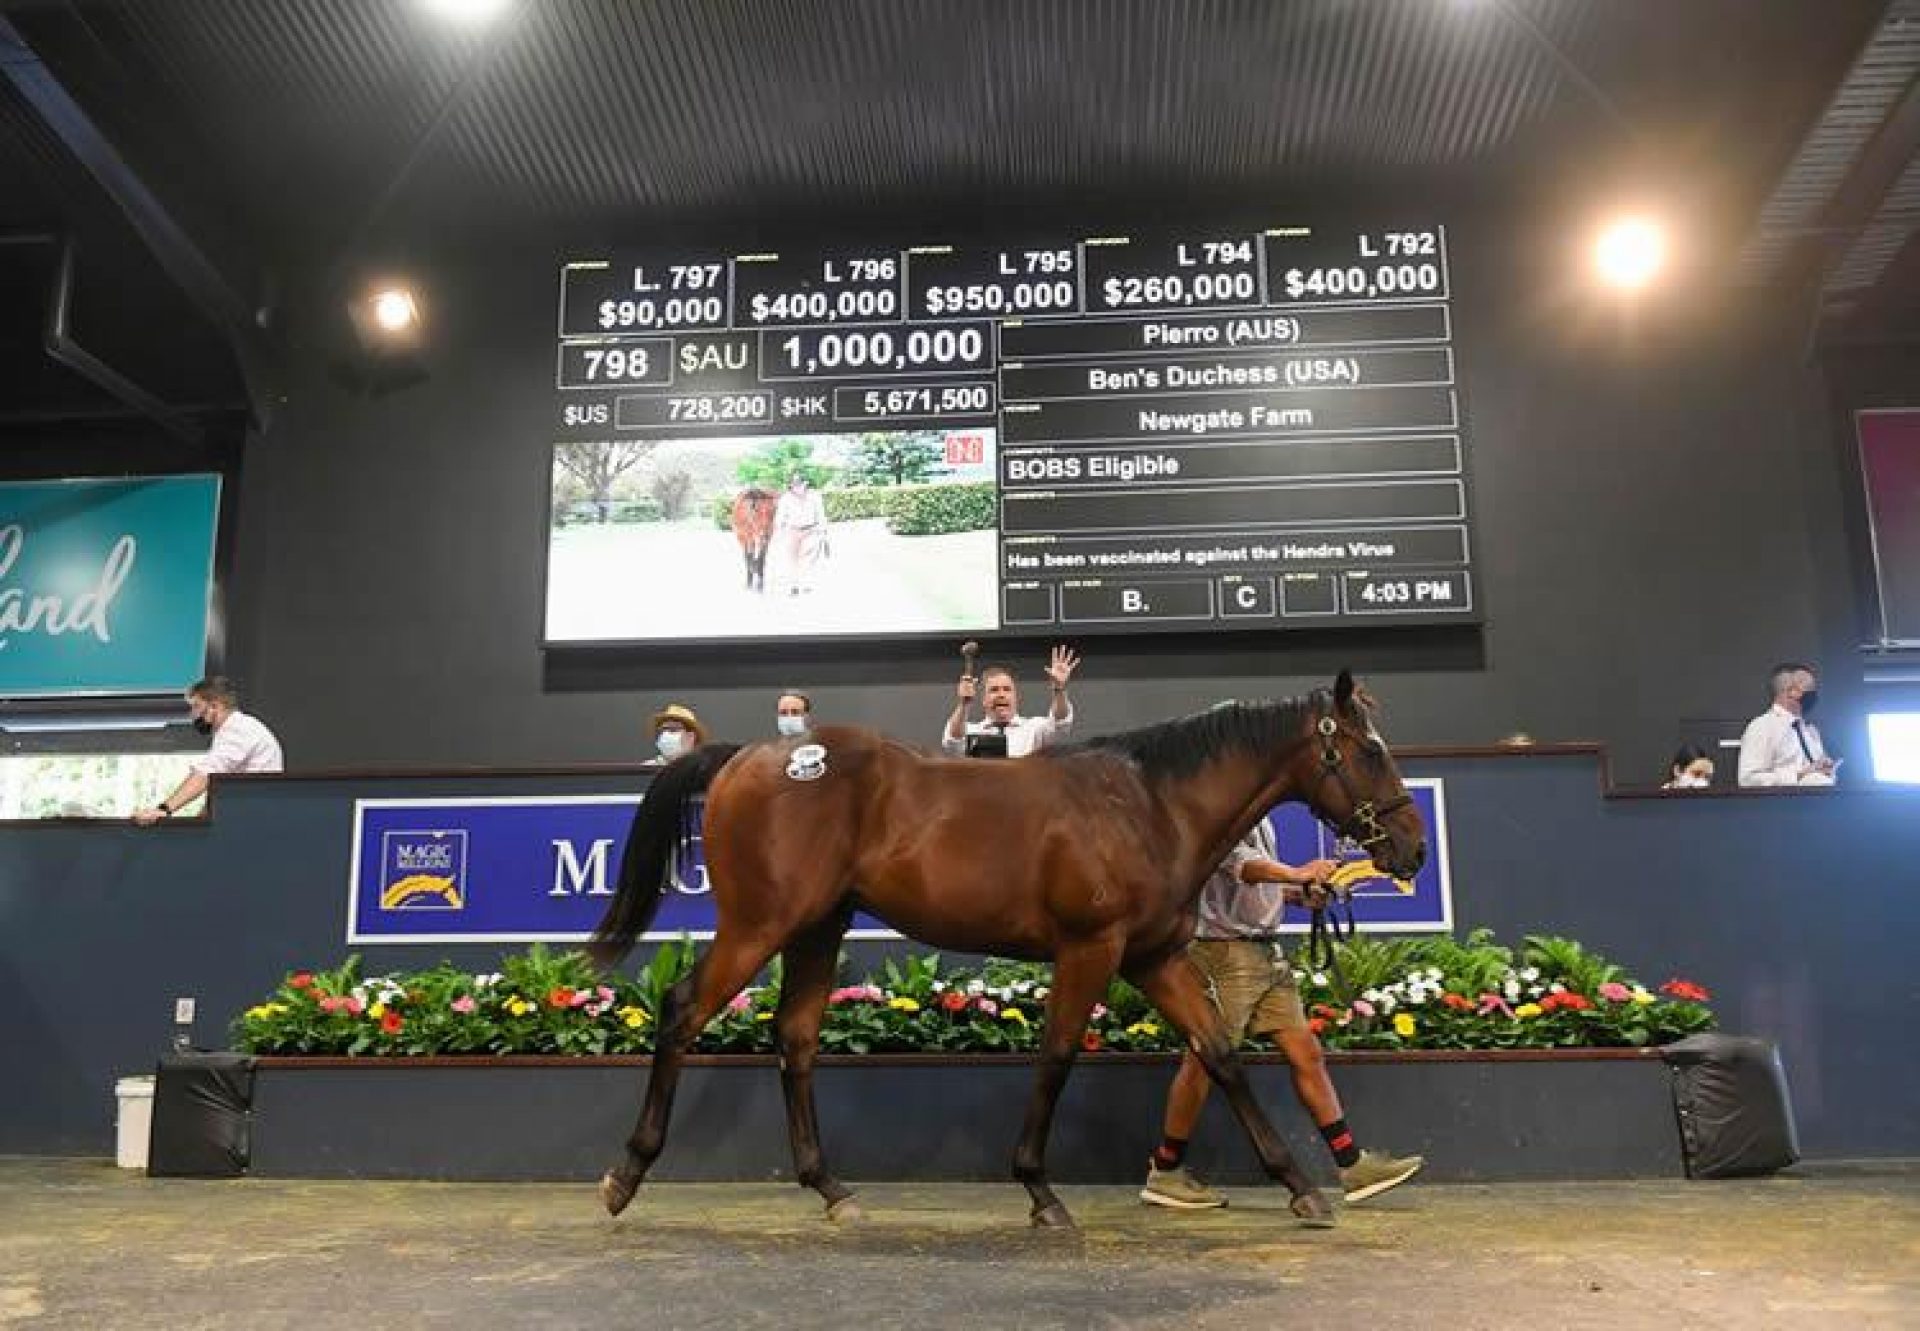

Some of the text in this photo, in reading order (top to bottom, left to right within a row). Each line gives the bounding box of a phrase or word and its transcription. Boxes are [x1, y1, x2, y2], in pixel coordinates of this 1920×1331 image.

[1178, 241, 1252, 266] L 794
[1359, 232, 1435, 257] L 792
[825, 259, 896, 282] L 796
[1000, 250, 1072, 275] L 795
[634, 264, 723, 290] L. 797
[1104, 273, 1253, 307] $260,000
[1284, 264, 1438, 297] $400,000
[751, 289, 896, 321] $400,000
[926, 281, 1073, 313] $950,000
[599, 297, 722, 329] $90,000
[1143, 319, 1300, 346] Pierro (AUS)
[583, 348, 650, 380] 798
[680, 343, 748, 372] $AU
[783, 329, 982, 373] 1,000,000
[1089, 358, 1361, 390] Ben's Duchess (USA)
[564, 404, 609, 426] $US
[668, 396, 766, 423] 728,200
[780, 396, 827, 418] $HK
[864, 387, 988, 417] 5,671,500
[1139, 407, 1312, 434] Newgate Farm
[1009, 455, 1179, 480] BOBS Eligible
[1008, 541, 1396, 567] Has been vaccinated against the Hendra Virus
[1123, 590, 1150, 612] B.
[1236, 585, 1257, 607] C
[1362, 581, 1452, 602] 4:03 PM
